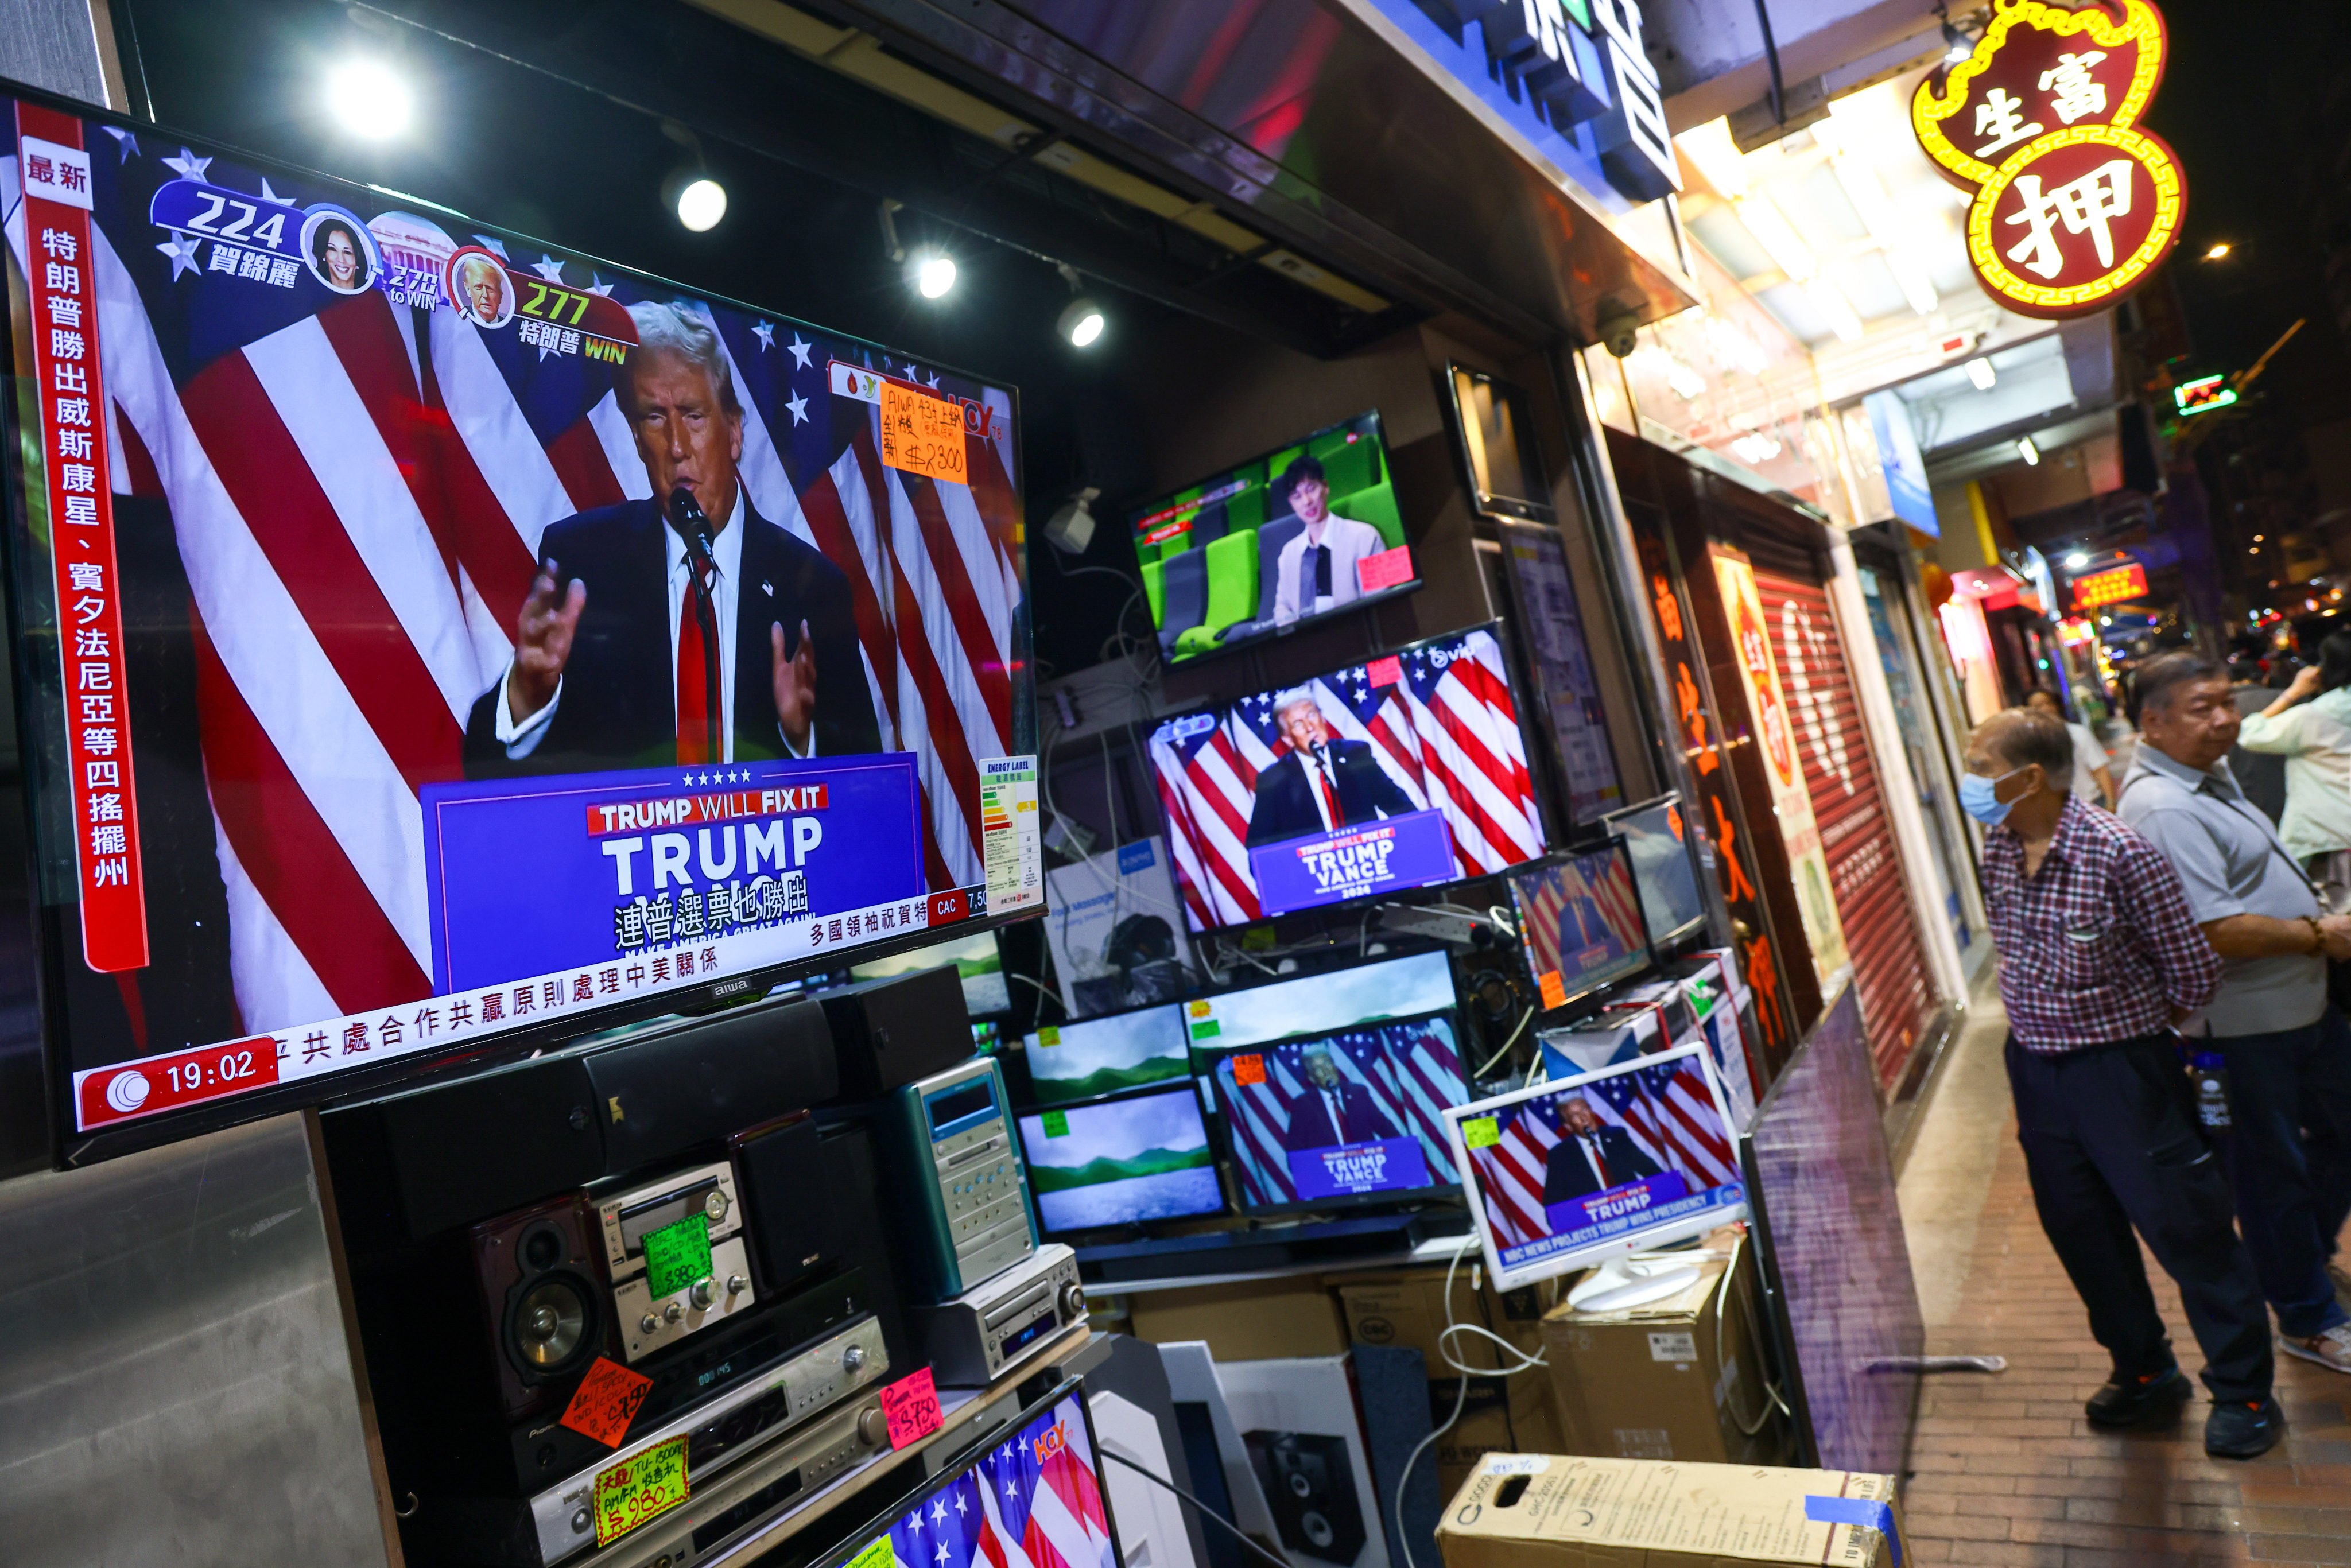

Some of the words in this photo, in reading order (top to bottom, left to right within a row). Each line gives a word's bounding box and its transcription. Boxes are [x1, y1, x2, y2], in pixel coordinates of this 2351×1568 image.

[26, 153, 87, 195] 最新
[187, 191, 287, 249] 224
[2005, 159, 2134, 280] 押
[207, 243, 301, 289] 賀錦麗
[389, 265, 439, 293] 270
[390, 288, 406, 305] to
[406, 291, 437, 313] WIN
[522, 282, 589, 325] 277
[519, 320, 580, 355] 特朗普
[585, 336, 626, 366] WIN
[888, 390, 915, 415] AIWA
[905, 443, 963, 475] $2300
[41, 227, 129, 888] 特朗普勝出威斯康星、賓夕法尼亞等四搖擺州
[988, 762, 1011, 773] ENERGY
[1012, 760, 1029, 771] LABEL
[599, 799, 692, 832] TRUMP
[697, 793, 756, 821] WILL
[761, 786, 796, 814] FIX
[801, 786, 820, 810] IT
[602, 816, 823, 896] TRUMP
[1302, 839, 1394, 875] TRUMP
[1316, 859, 1389, 887] VANCE
[615, 876, 809, 950] 連普選票也勝出
[810, 901, 928, 947] 多國領袖祝賀特
[937, 898, 956, 915] CAC
[715, 980, 748, 995] aiwa
[167, 1050, 255, 1093] 19:02
[1324, 1154, 1387, 1174] TRUMP
[1504, 1247, 1526, 1264] NBC
[1525, 1239, 1551, 1259] NEWS
[1552, 1227, 1600, 1253] PROJECTS
[1600, 1218, 1628, 1240] TRUMP
[1653, 1194, 1707, 1222] PRESIDENCY
[1586, 1193, 1651, 1223] TRUMP
[1033, 1419, 1065, 1466] HOY
[604, 1484, 637, 1513] AM/FM
[608, 1485, 665, 1534] $980
